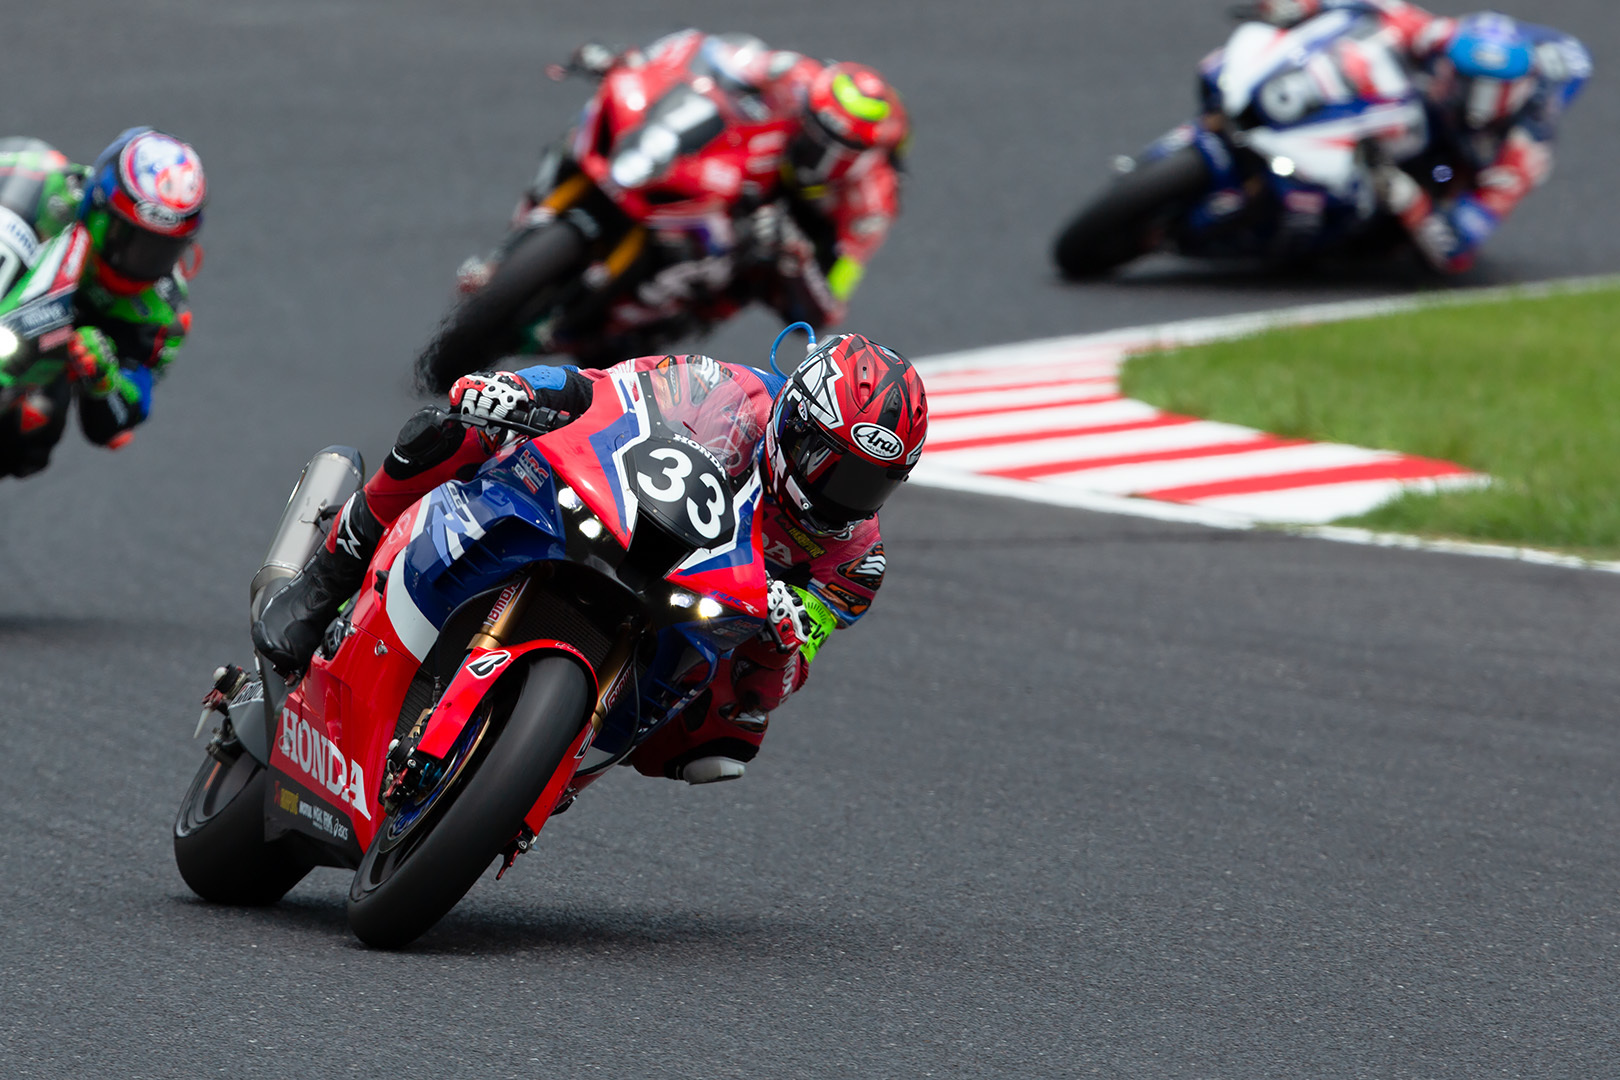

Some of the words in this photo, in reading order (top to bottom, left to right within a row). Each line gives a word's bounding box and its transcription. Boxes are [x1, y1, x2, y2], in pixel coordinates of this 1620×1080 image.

[672, 433, 727, 480] HONDA
[855, 429, 899, 454] Arai
[519, 449, 549, 484] HRC
[636, 447, 726, 539] 33
[279, 707, 372, 821] HONDA
